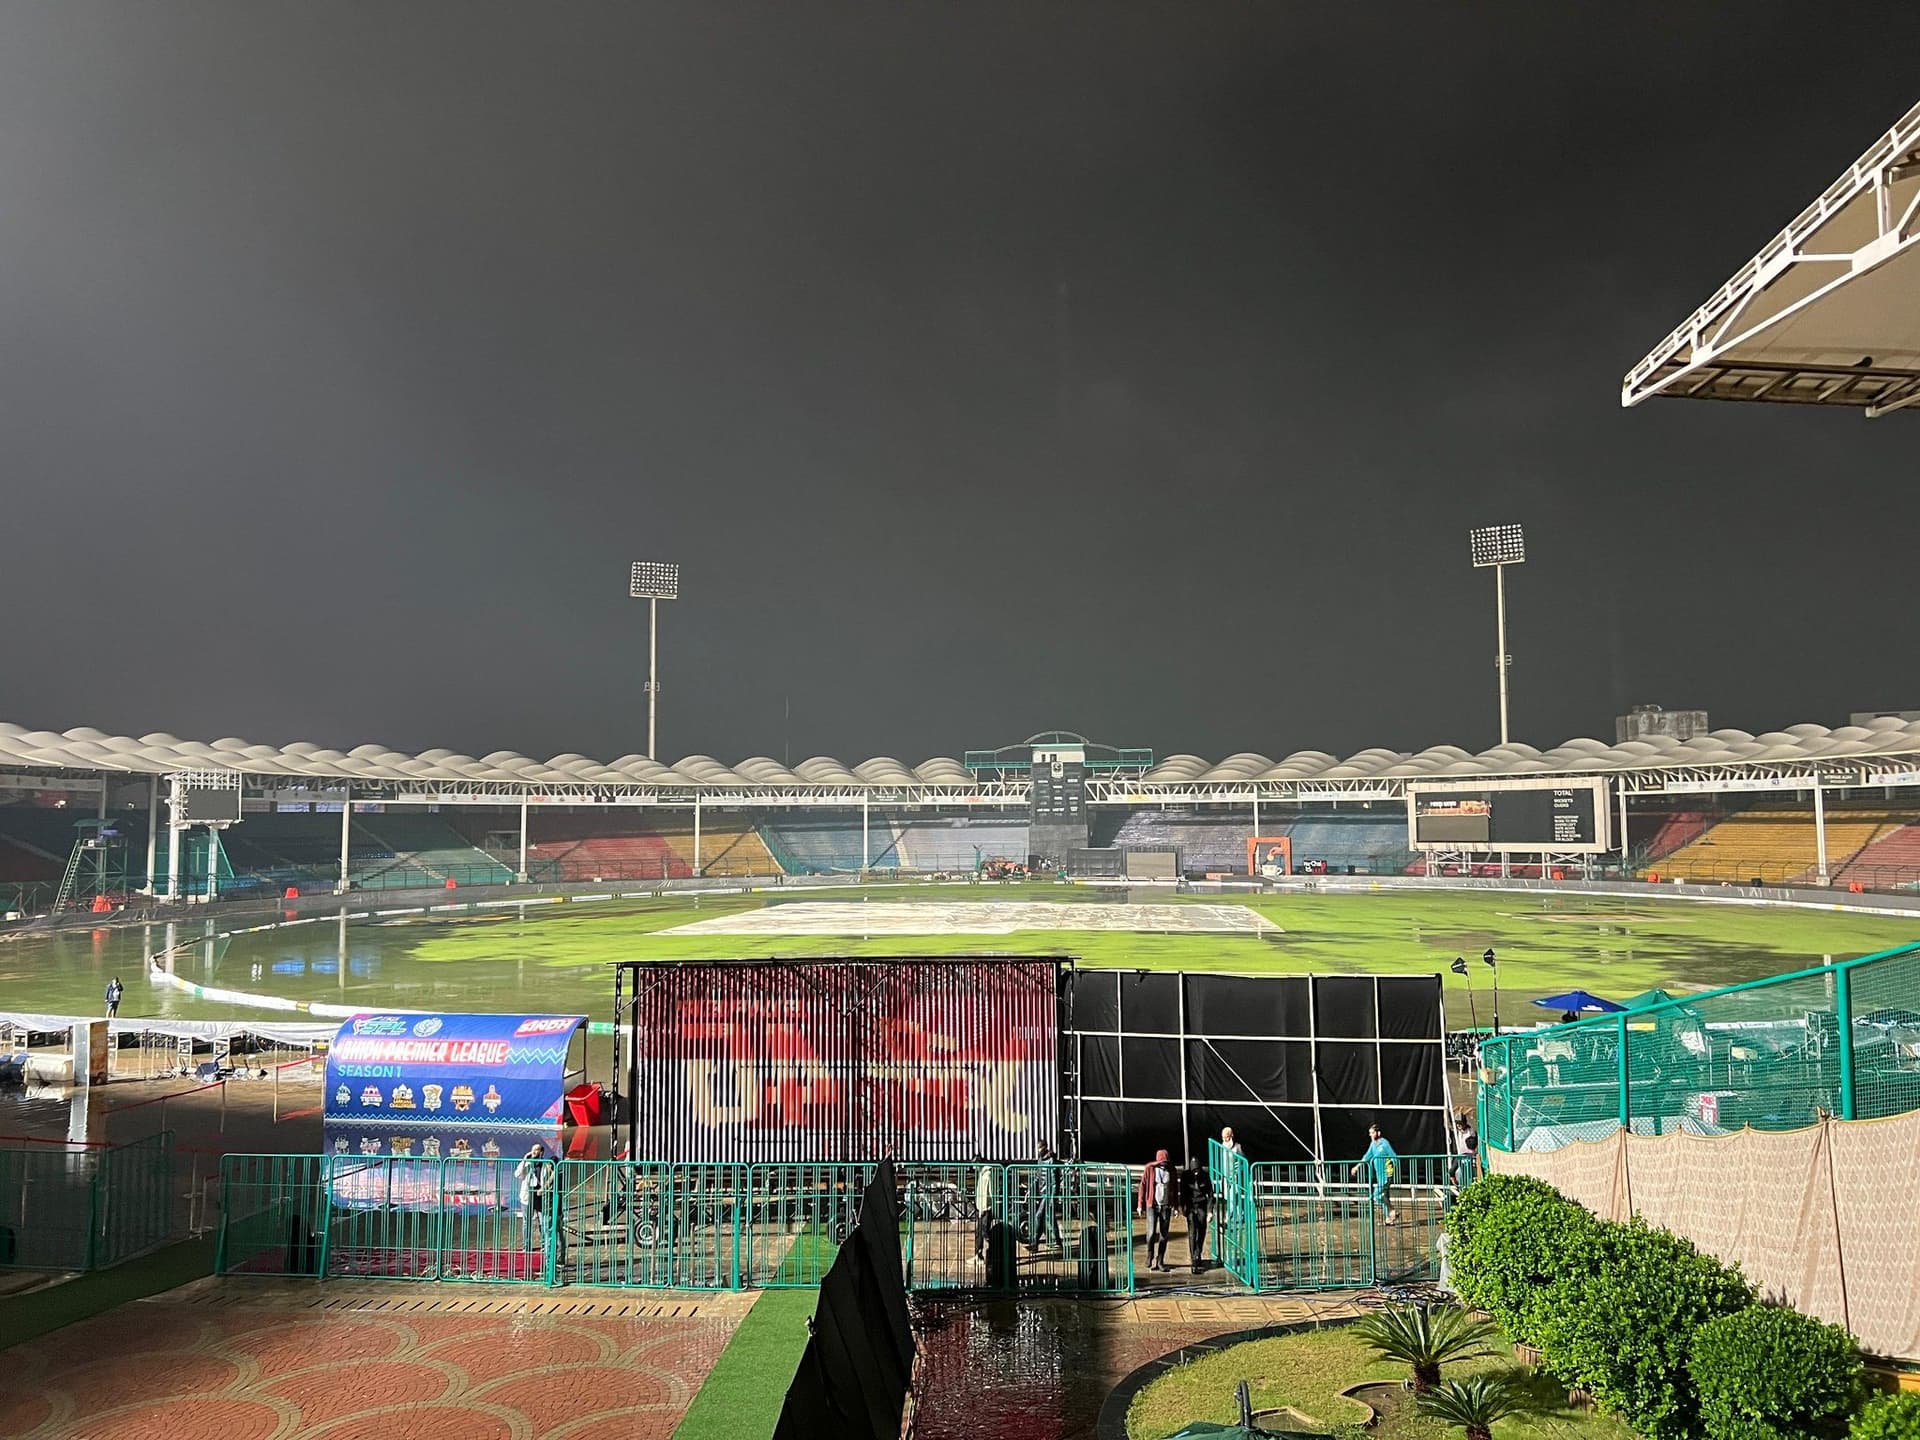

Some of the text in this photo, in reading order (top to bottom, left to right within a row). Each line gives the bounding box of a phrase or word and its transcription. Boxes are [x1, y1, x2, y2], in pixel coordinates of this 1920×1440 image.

[385, 1040, 448, 1063] PREMIER
[450, 1041, 507, 1065] LEAGUE
[338, 1064, 402, 1078] SEASON 1
